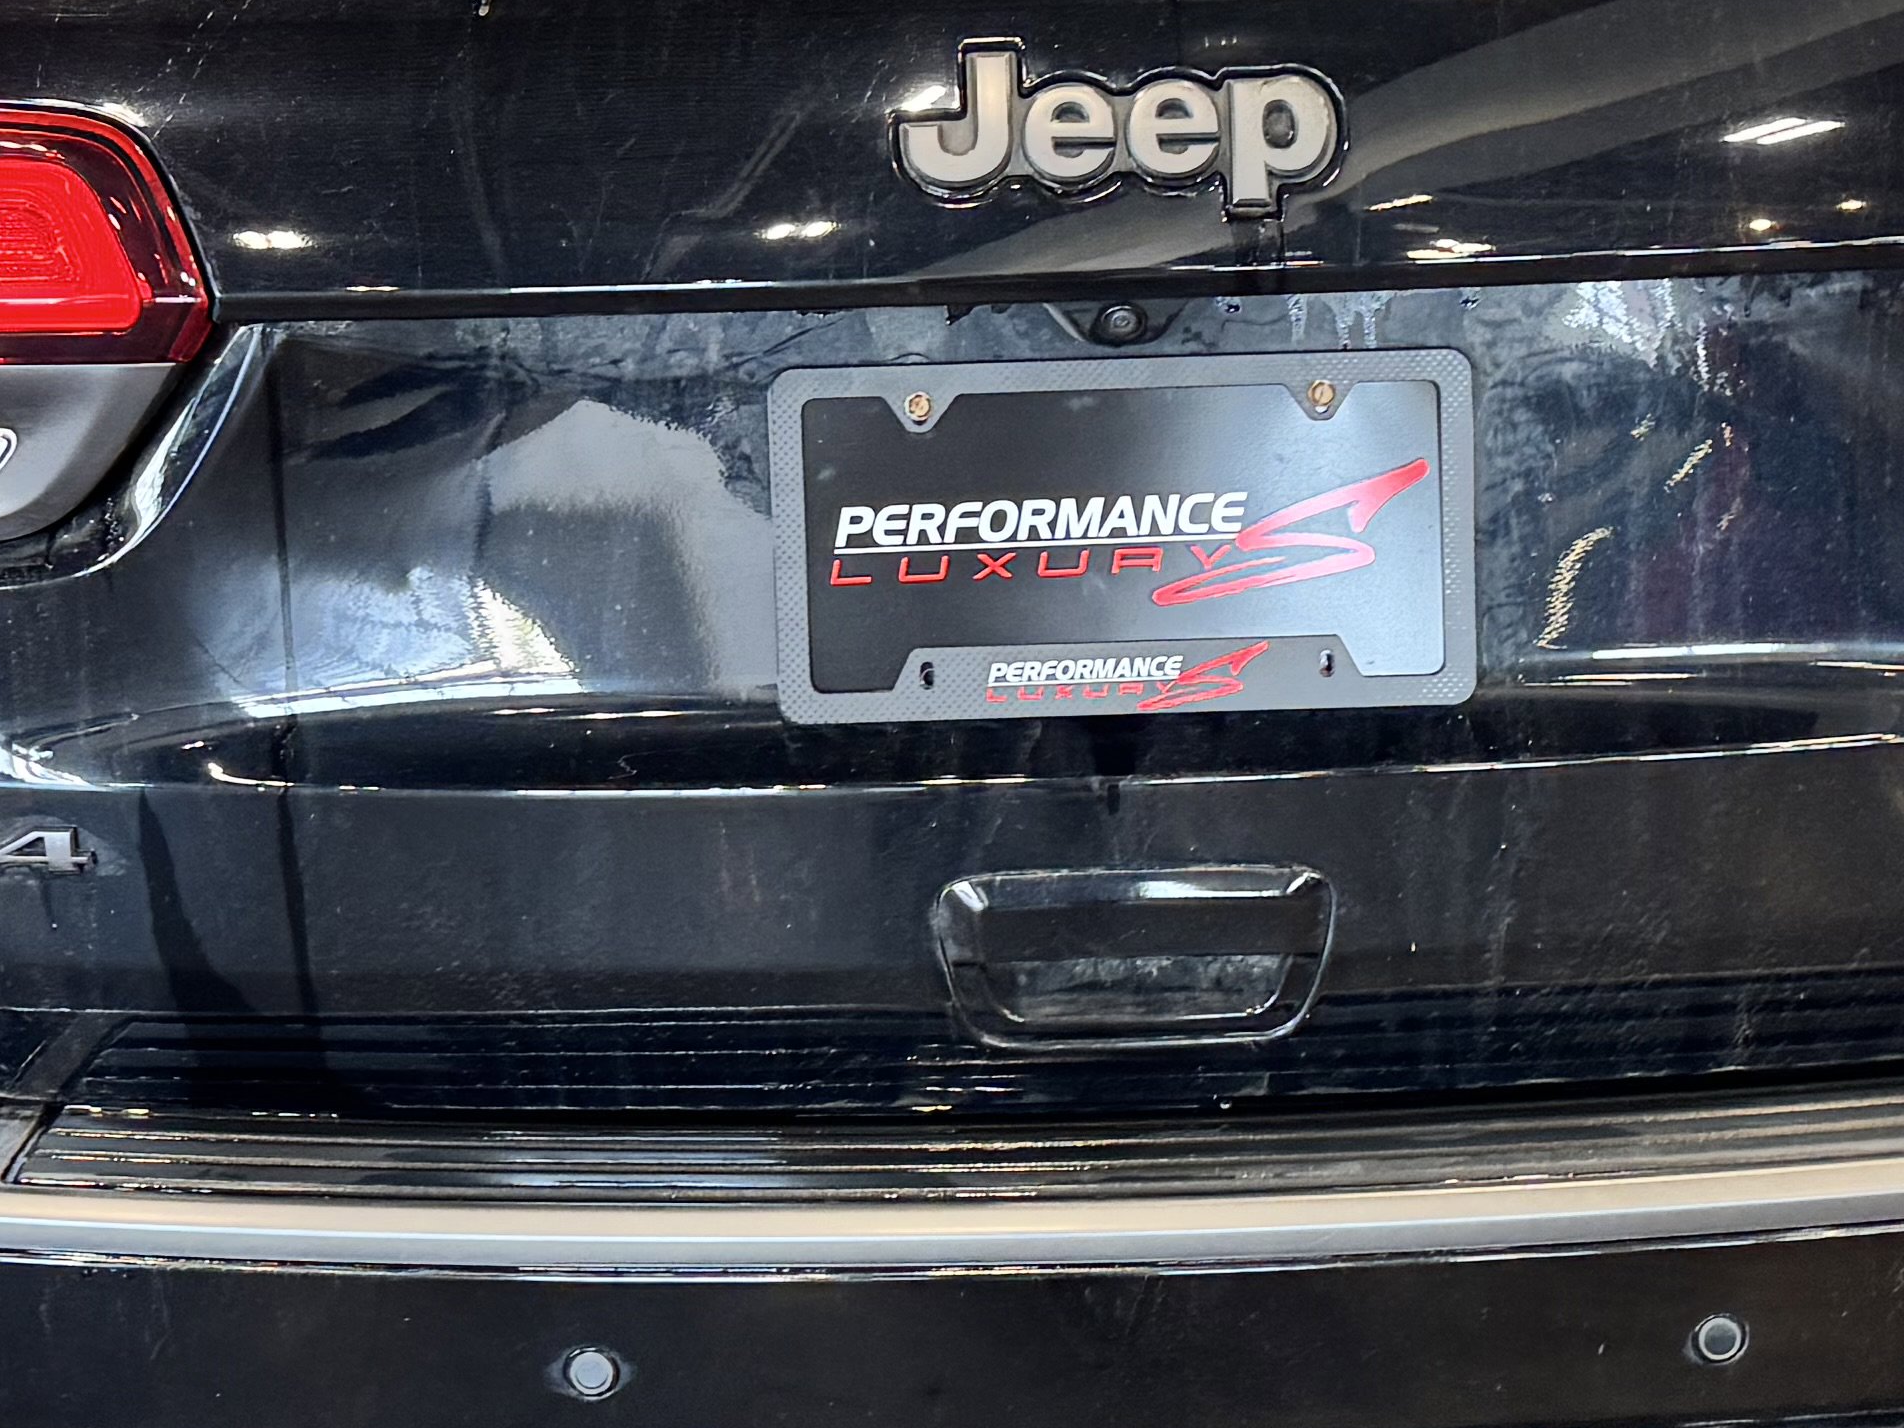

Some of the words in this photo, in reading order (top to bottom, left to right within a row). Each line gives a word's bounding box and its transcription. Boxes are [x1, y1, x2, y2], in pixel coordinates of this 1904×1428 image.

[896, 48, 1339, 210] Jeep
[834, 491, 1249, 548] PERFORMANCE
[829, 544, 1232, 586] LUXURY
[987, 655, 1184, 684] PERFORMANCE
